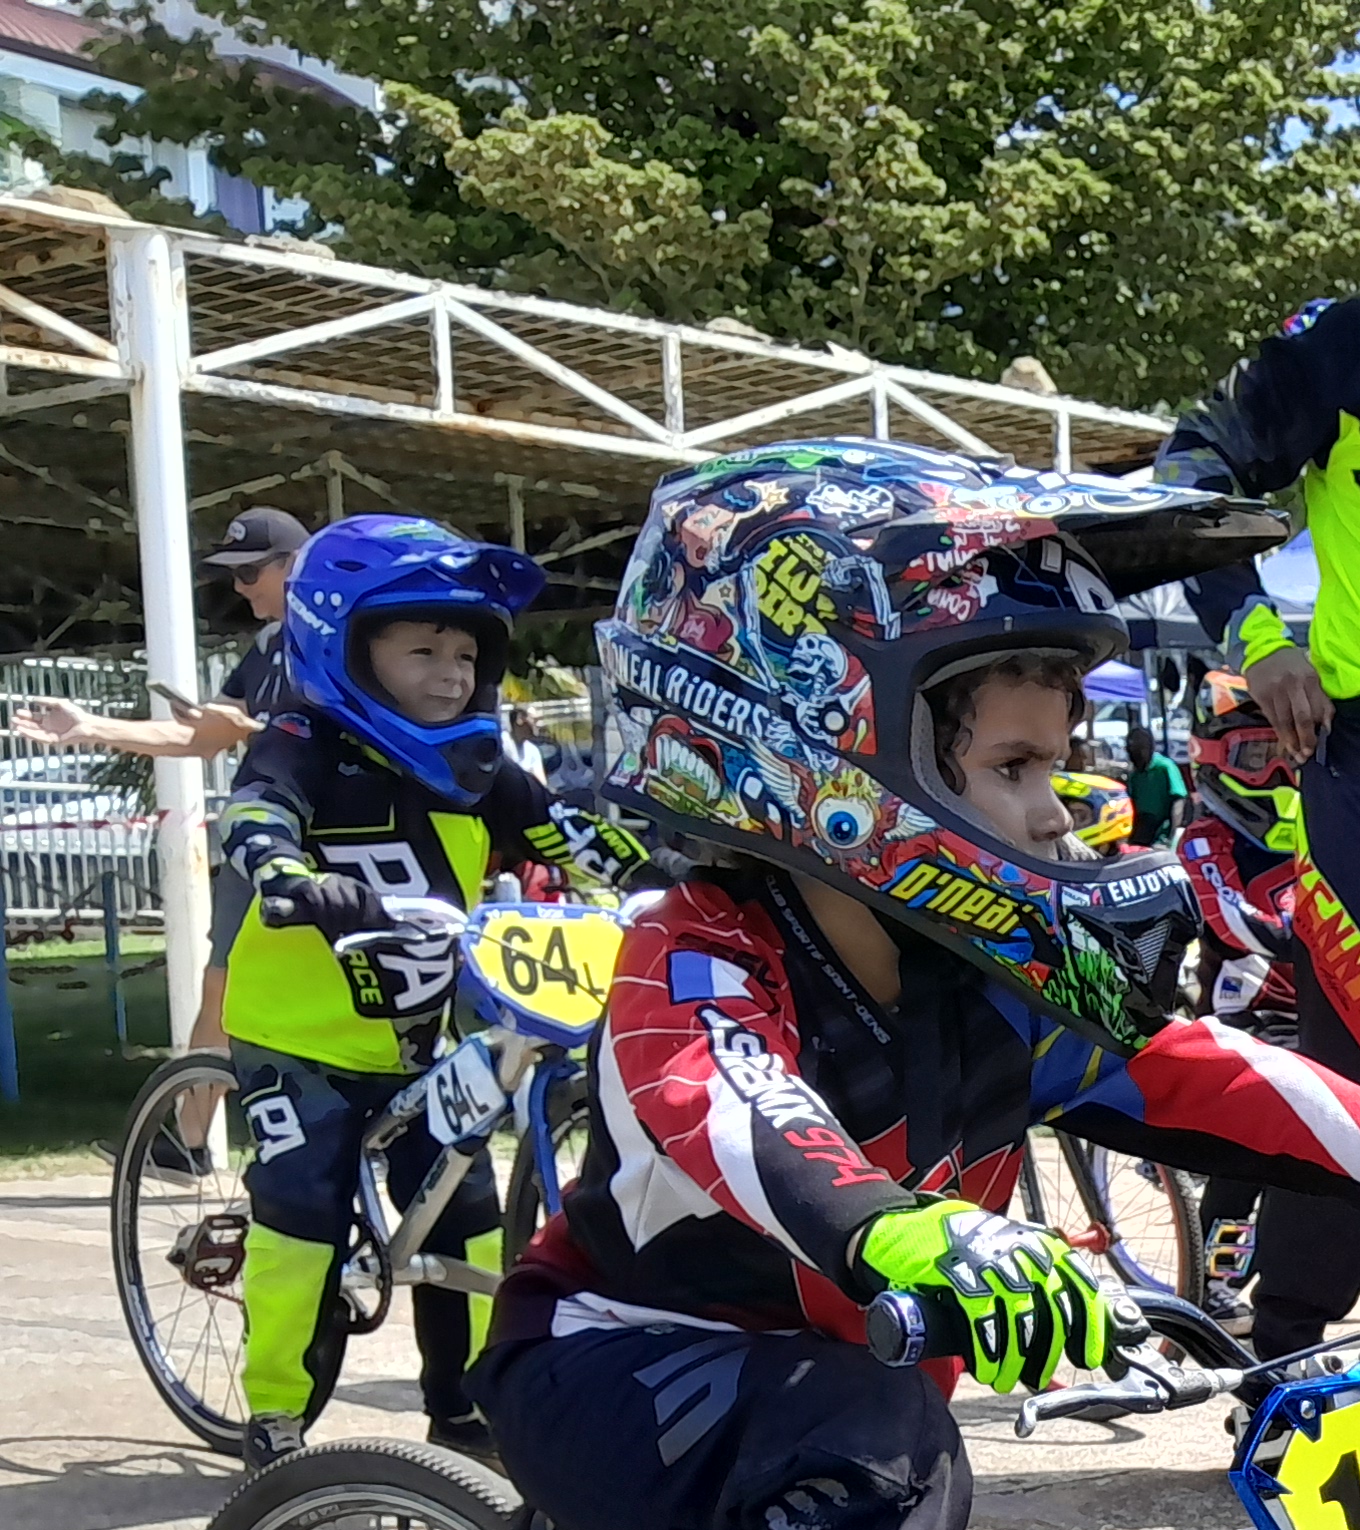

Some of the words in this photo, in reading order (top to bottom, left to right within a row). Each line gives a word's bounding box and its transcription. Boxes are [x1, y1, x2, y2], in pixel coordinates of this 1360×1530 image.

[1109, 866, 1173, 901] ENJOY
[782, 908, 825, 963] SPORTIF
[347, 948, 384, 1006] ACE
